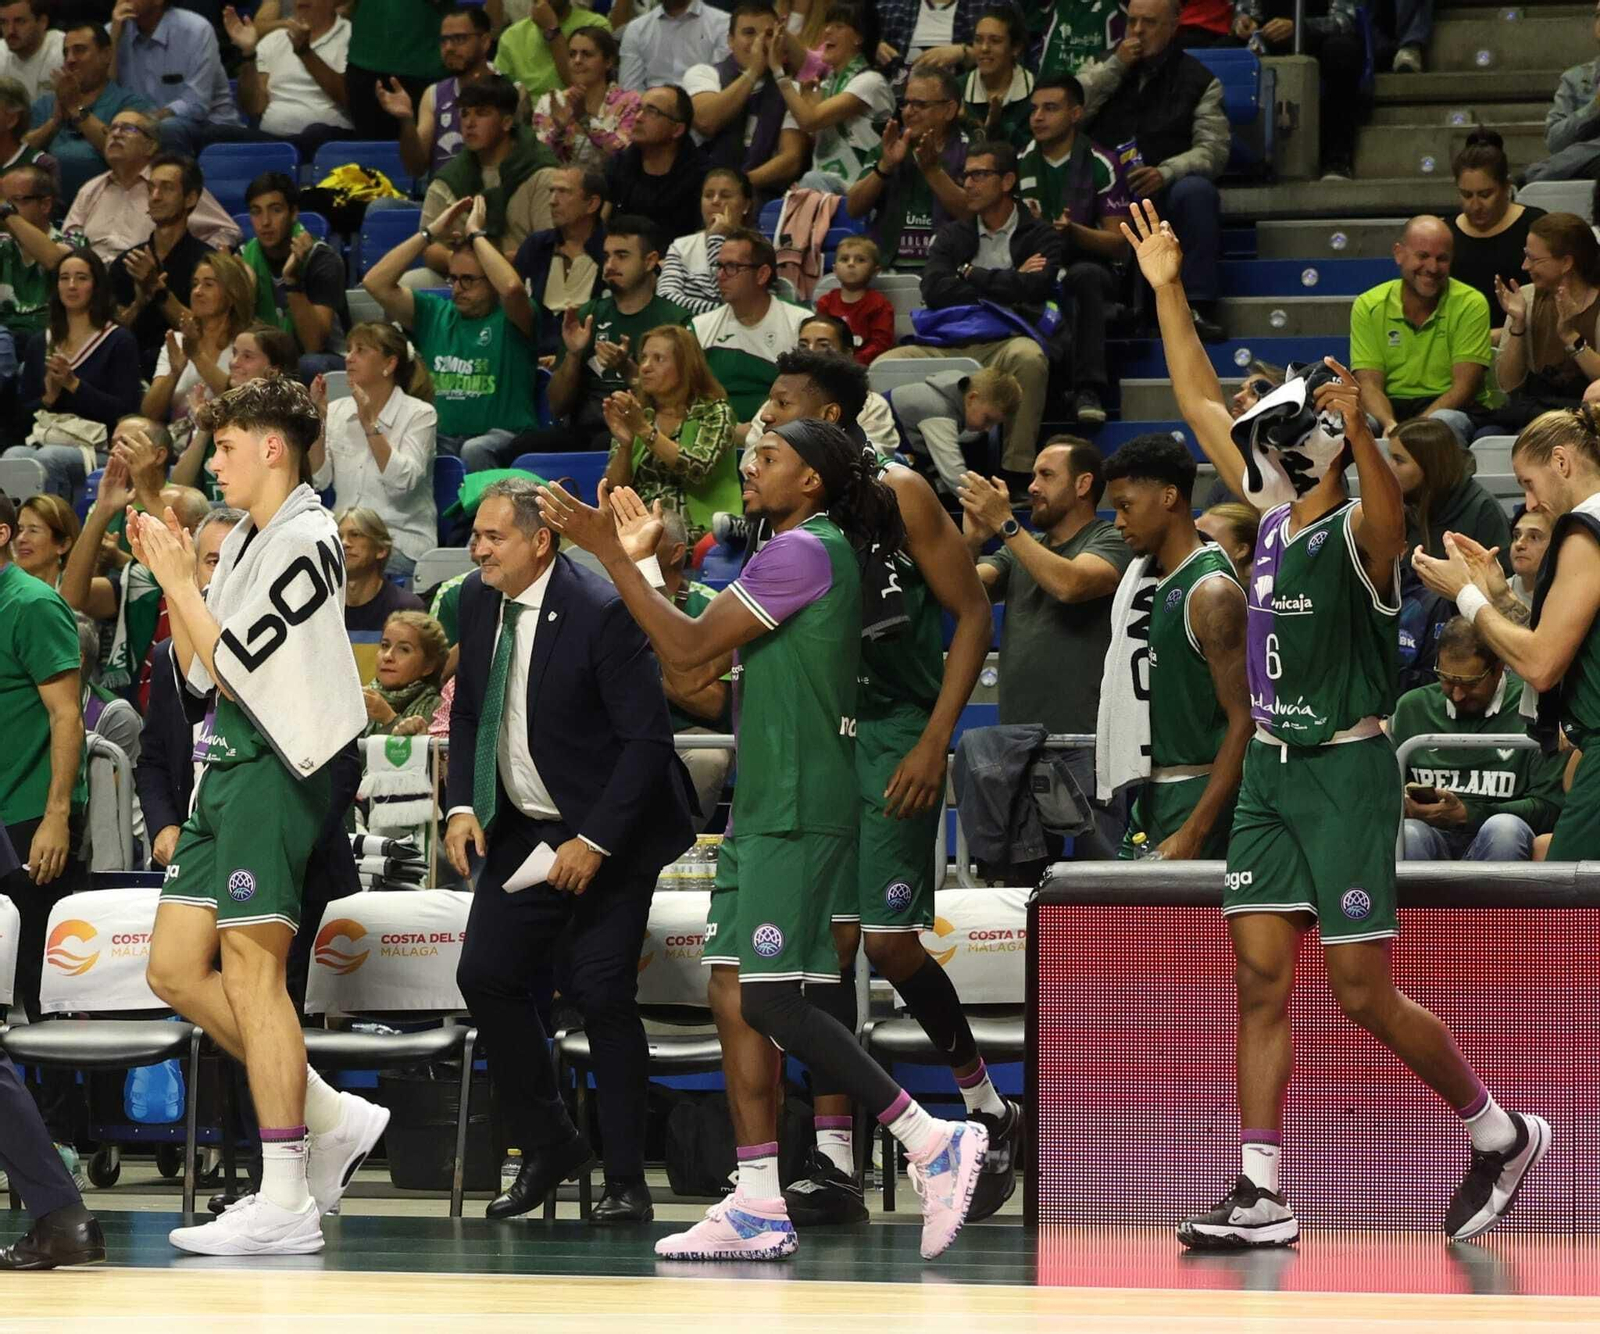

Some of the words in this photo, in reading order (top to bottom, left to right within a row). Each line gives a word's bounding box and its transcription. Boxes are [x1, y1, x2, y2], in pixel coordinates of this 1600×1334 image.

[1266, 633, 1282, 680] 6
[381, 934, 426, 944] COSTA
[429, 933, 456, 943] DEL
[968, 930, 1013, 940] COSTA
